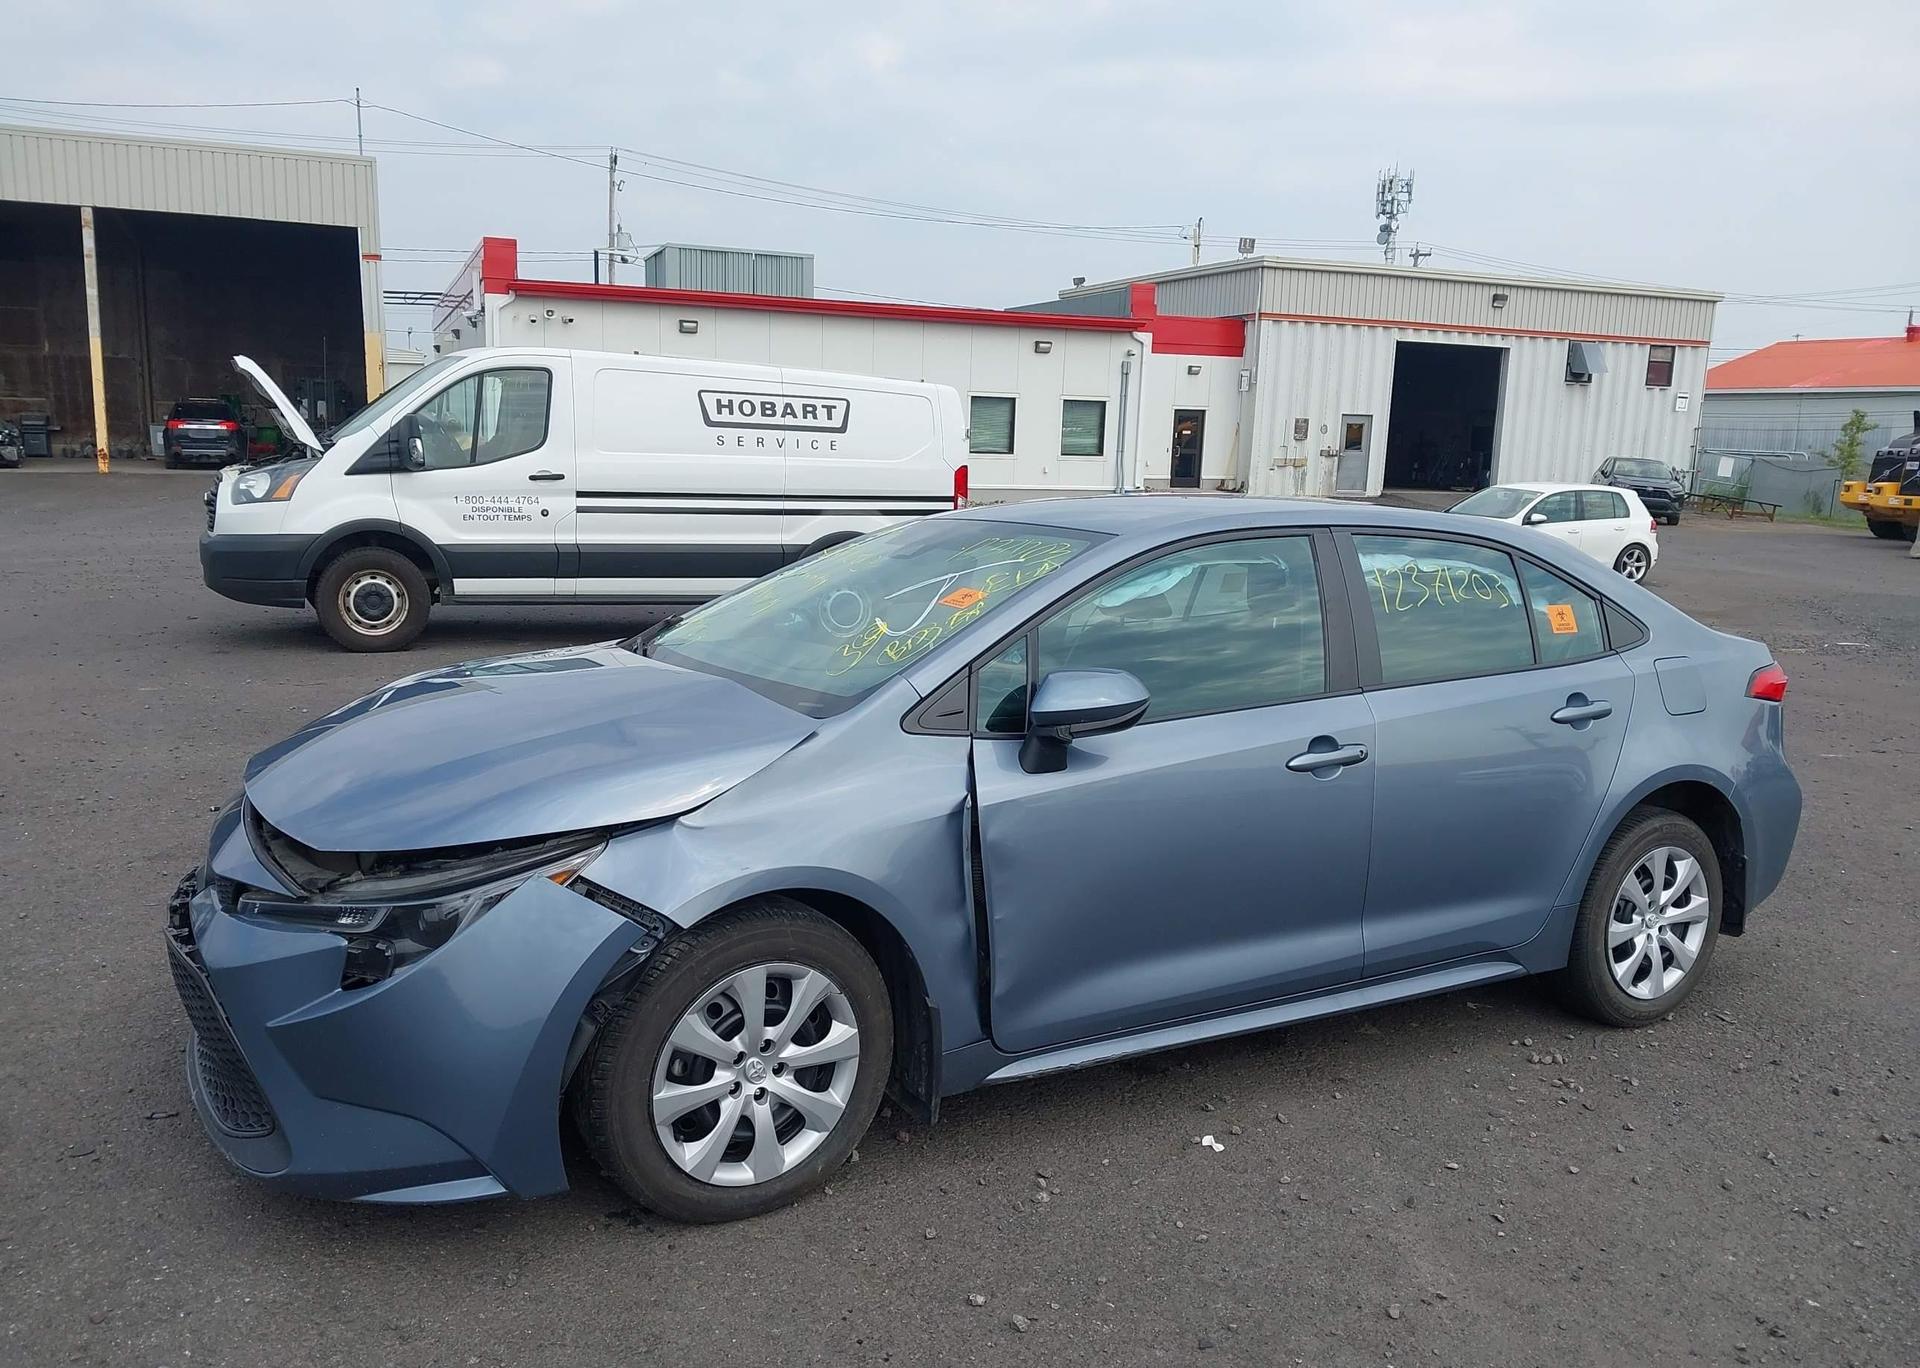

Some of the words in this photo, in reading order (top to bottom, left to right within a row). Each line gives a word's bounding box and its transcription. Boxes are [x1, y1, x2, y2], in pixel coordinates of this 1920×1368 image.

[716, 398, 837, 421] HOBART
[716, 435, 837, 451] SERVICE
[453, 495, 540, 505] 1-800-444-4764
[503, 514, 533, 522] TEMPS
